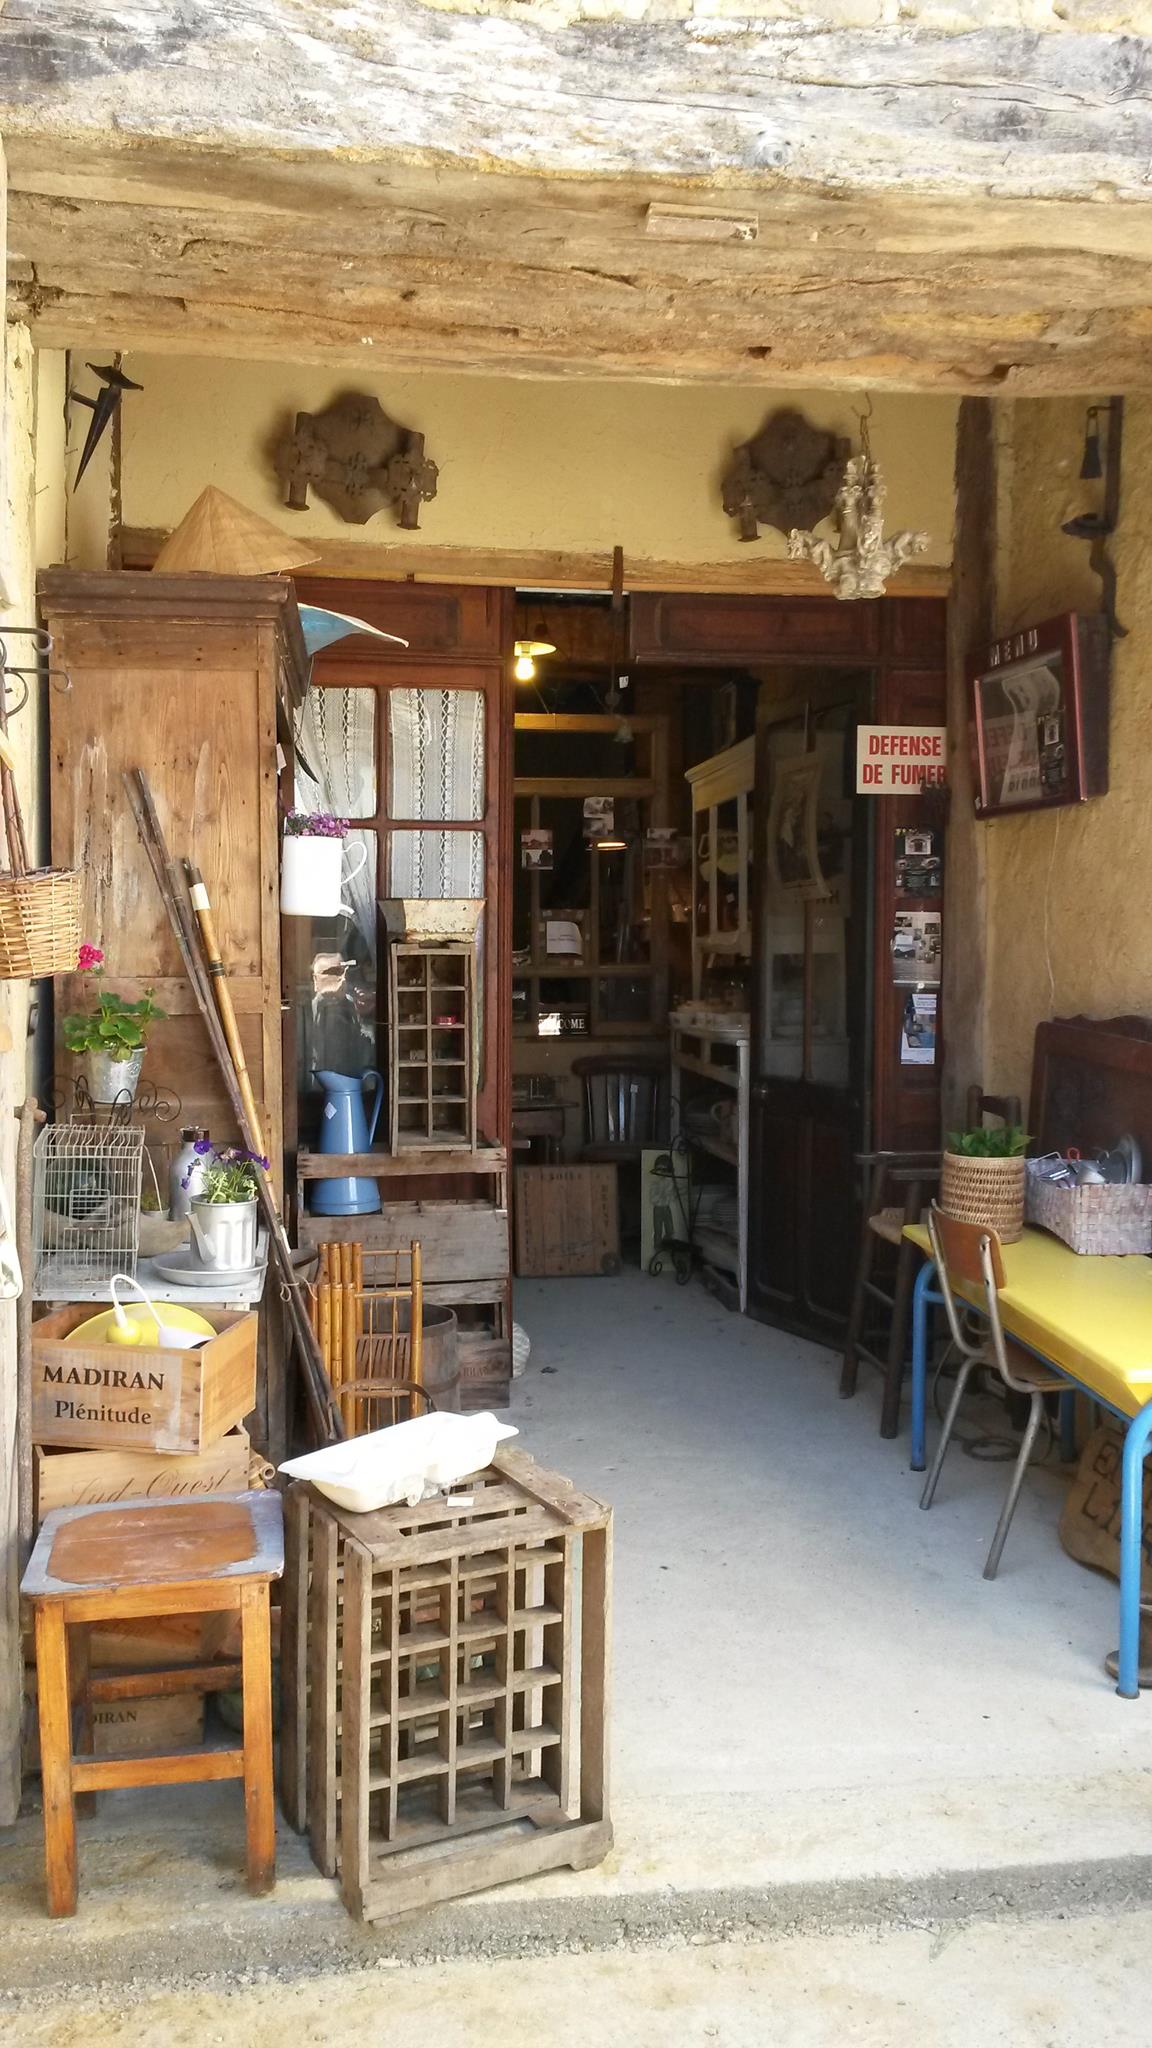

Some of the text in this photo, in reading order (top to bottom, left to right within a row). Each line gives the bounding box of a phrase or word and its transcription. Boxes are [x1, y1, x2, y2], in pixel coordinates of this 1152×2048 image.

[990, 629, 1038, 667] MENU
[869, 735, 941, 756] DEFENSE
[862, 763, 884, 785] DE
[43, 1365, 165, 1391] MADIRAN
[55, 1400, 152, 1424] Plénitude
